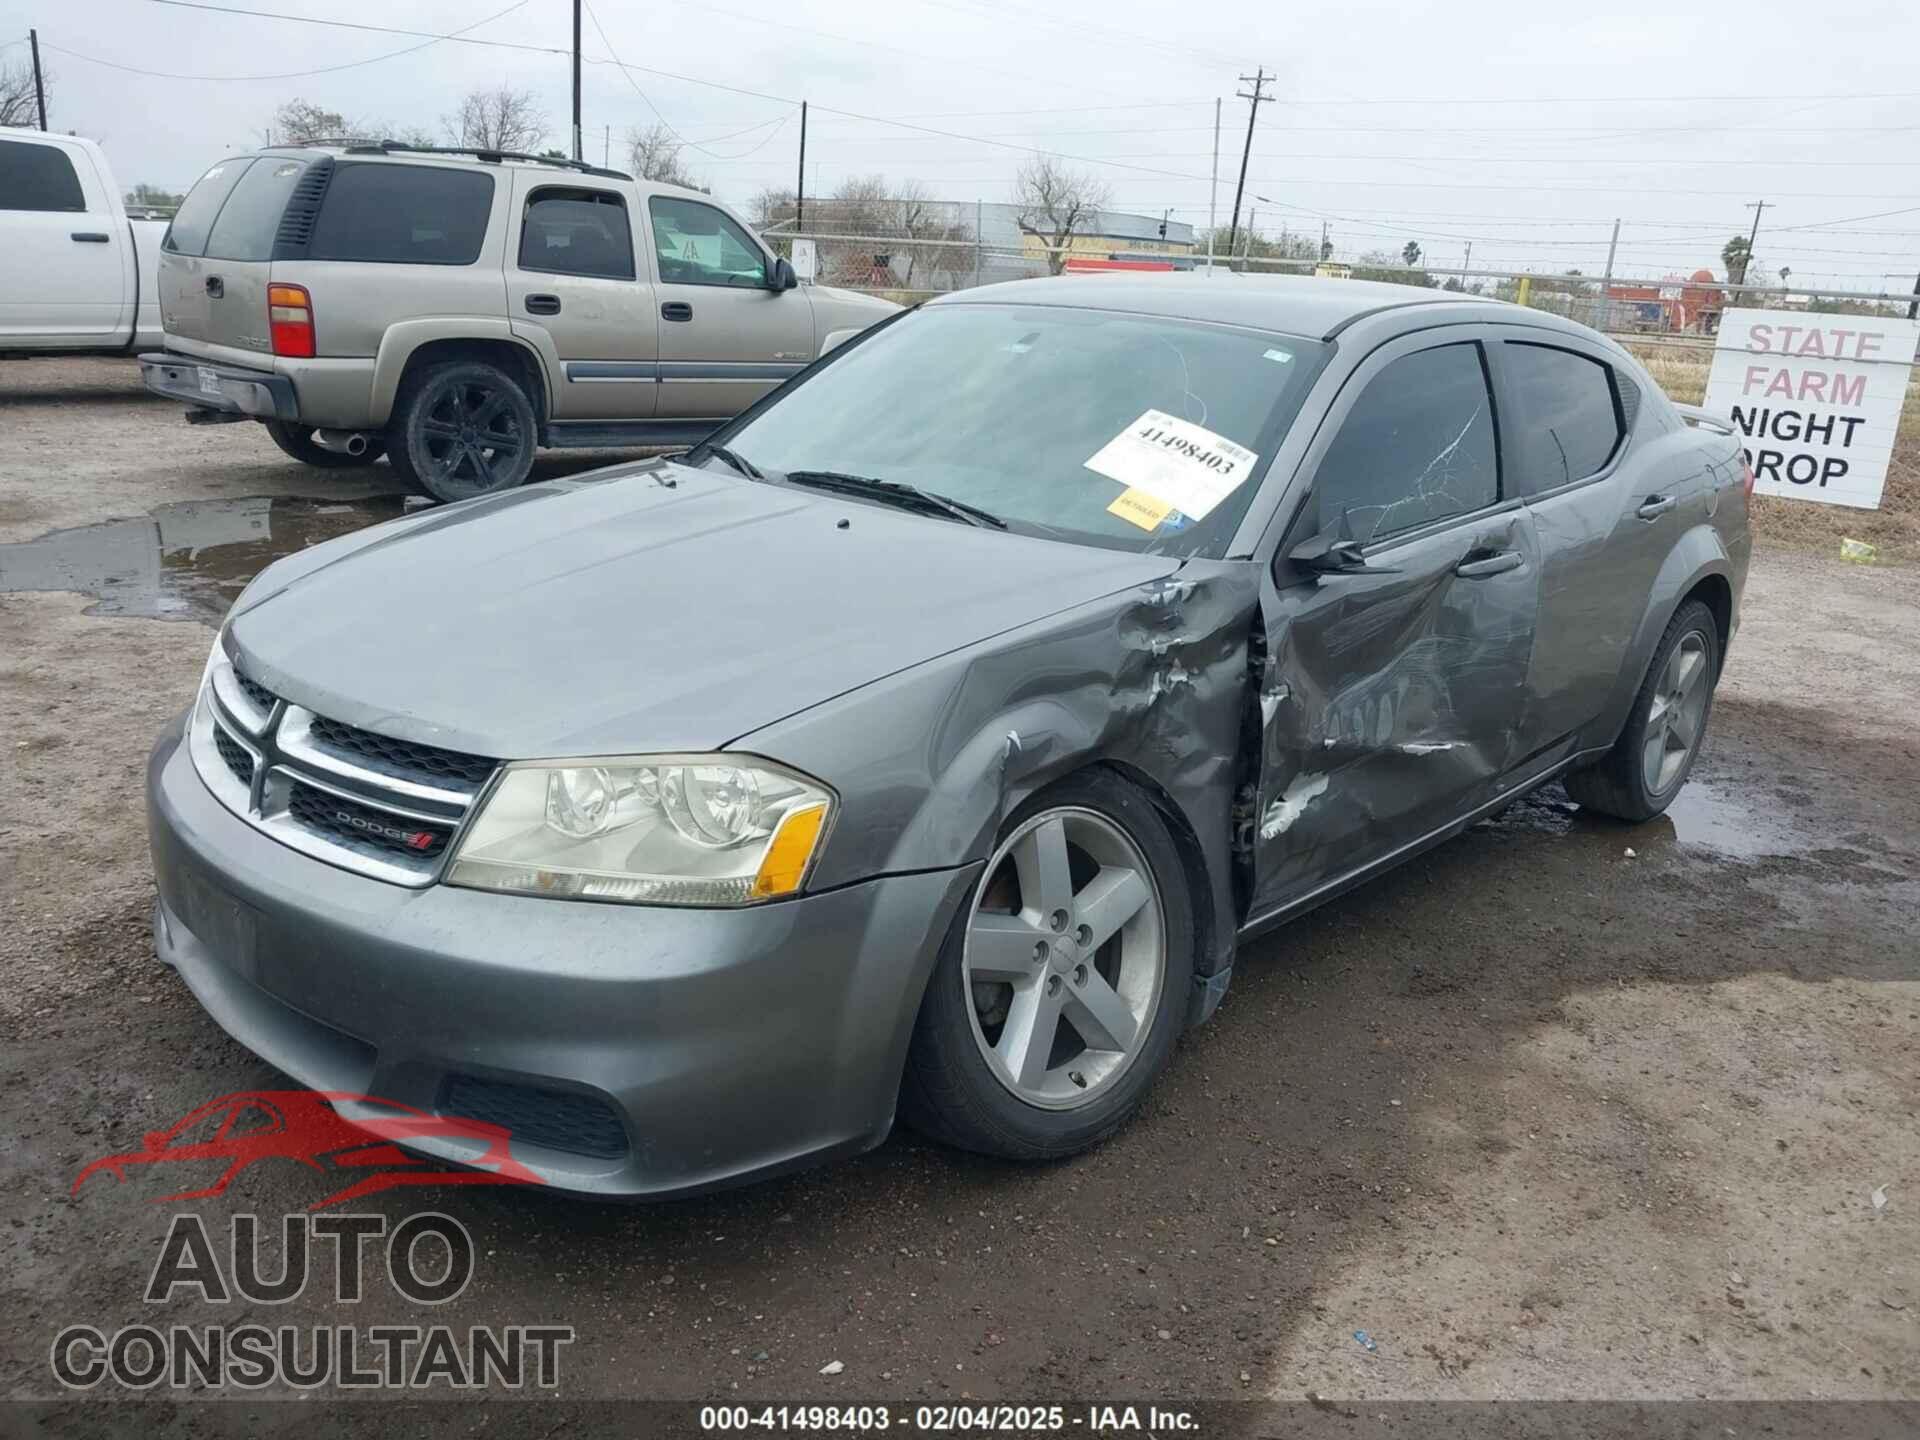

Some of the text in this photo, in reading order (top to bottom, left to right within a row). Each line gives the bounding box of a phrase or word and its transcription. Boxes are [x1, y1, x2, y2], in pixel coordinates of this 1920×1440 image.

[1746, 324, 1885, 363] STATE
[1742, 365, 1867, 407] FARM
[1730, 405, 1866, 448] NIGHT
[1139, 427, 1235, 474] 41498403
[336, 811, 418, 844] DODGE
